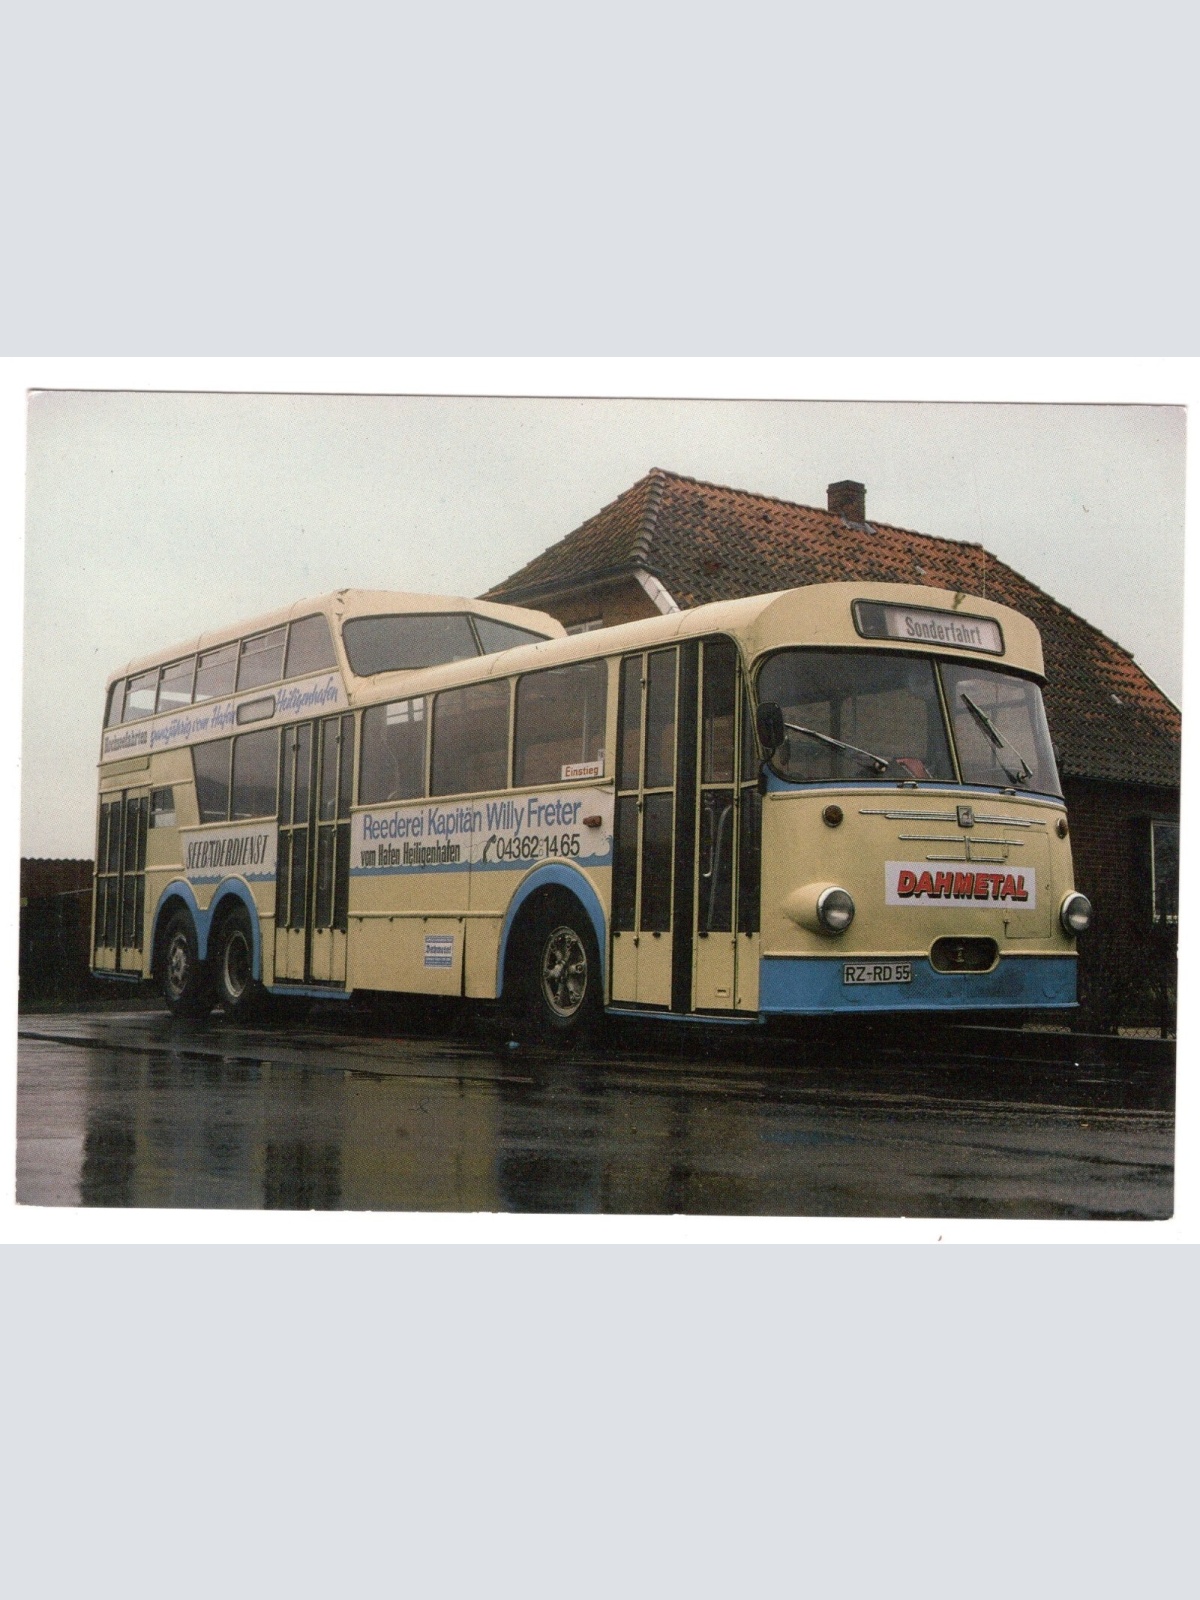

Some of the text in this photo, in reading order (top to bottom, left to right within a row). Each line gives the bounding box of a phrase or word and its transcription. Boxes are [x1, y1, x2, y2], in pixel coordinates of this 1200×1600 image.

[905, 616, 982, 645] Sonderfahrt
[276, 676, 338, 714] Heiligenhafen
[565, 766, 599, 777] Einstieg
[363, 797, 582, 841] Reederei Kapitän Willy Freter
[361, 840, 461, 869] vom Hafen Heiligenhafen
[897, 870, 1028, 901] DAHMETAL
[845, 965, 910, 982] RZ-RD 55
